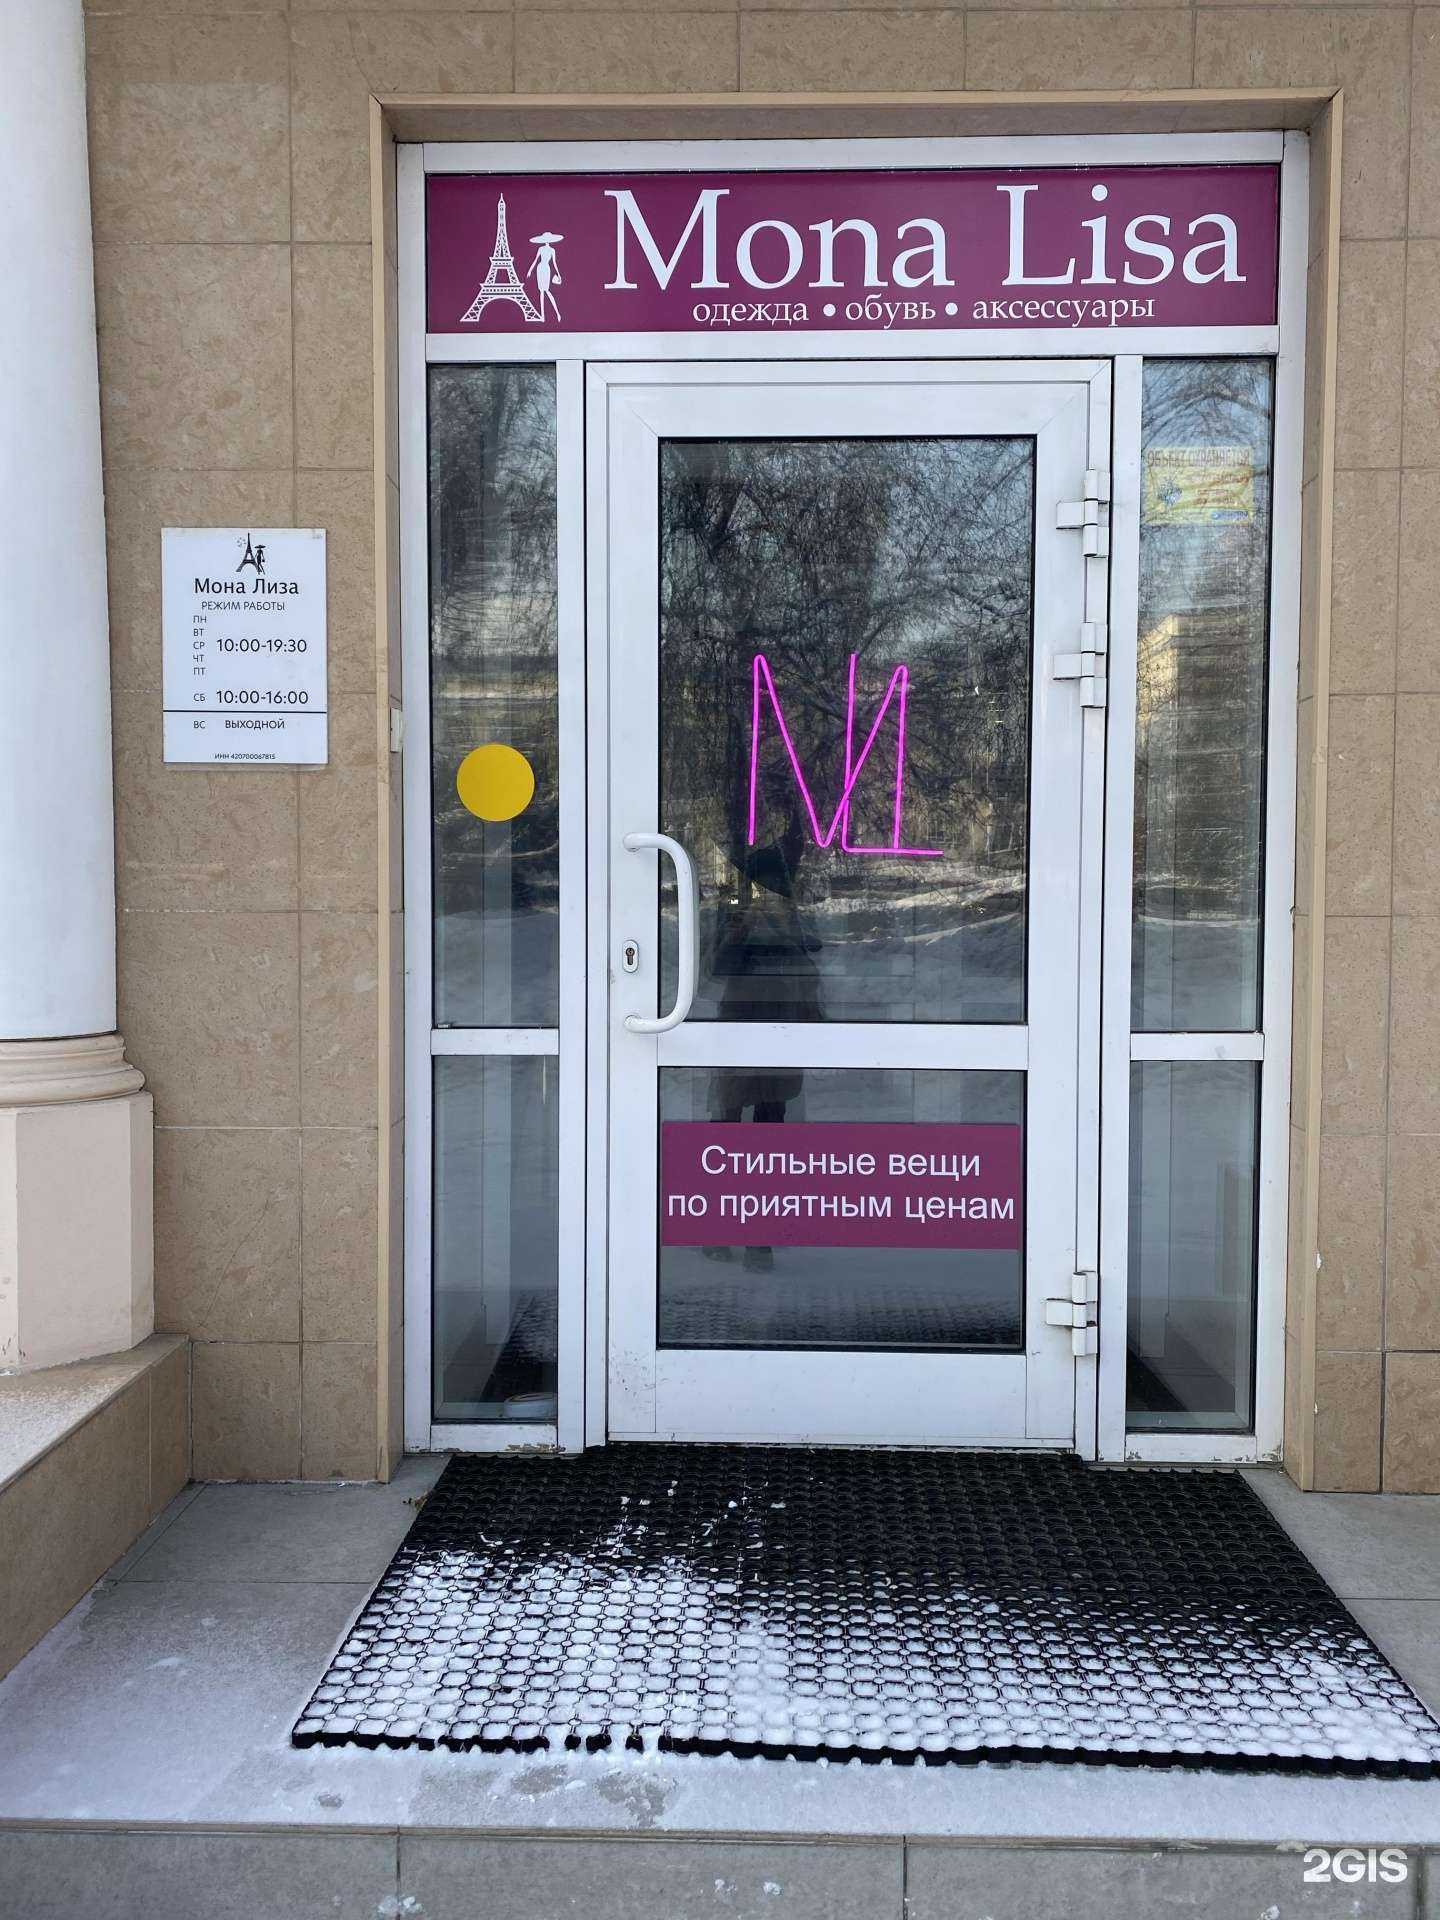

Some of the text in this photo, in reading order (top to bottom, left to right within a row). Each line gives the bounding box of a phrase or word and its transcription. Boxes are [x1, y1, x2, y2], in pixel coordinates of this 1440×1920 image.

[605, 185, 1246, 290] Mona Lisa
[693, 293, 1156, 327] одежда обувь аксессуары
[195, 578, 300, 595] Мона Лиза
[202, 601, 286, 612] РЕЖИМ РАБОТЫ
[193, 615, 207, 624] ПН
[194, 628, 205, 637] ВТ
[193, 639, 308, 653] СР 10:00-19:30
[193, 654, 205, 663] ЧТ
[194, 667, 207, 676] ПТ
[194, 691, 309, 705] СБ 10:00-16:00
[194, 718, 285, 731] ВС ВЫХОДНОЙ
[702, 1146, 979, 1181] Стильные вещи
[669, 1195, 1013, 1223] по приятным ценам
